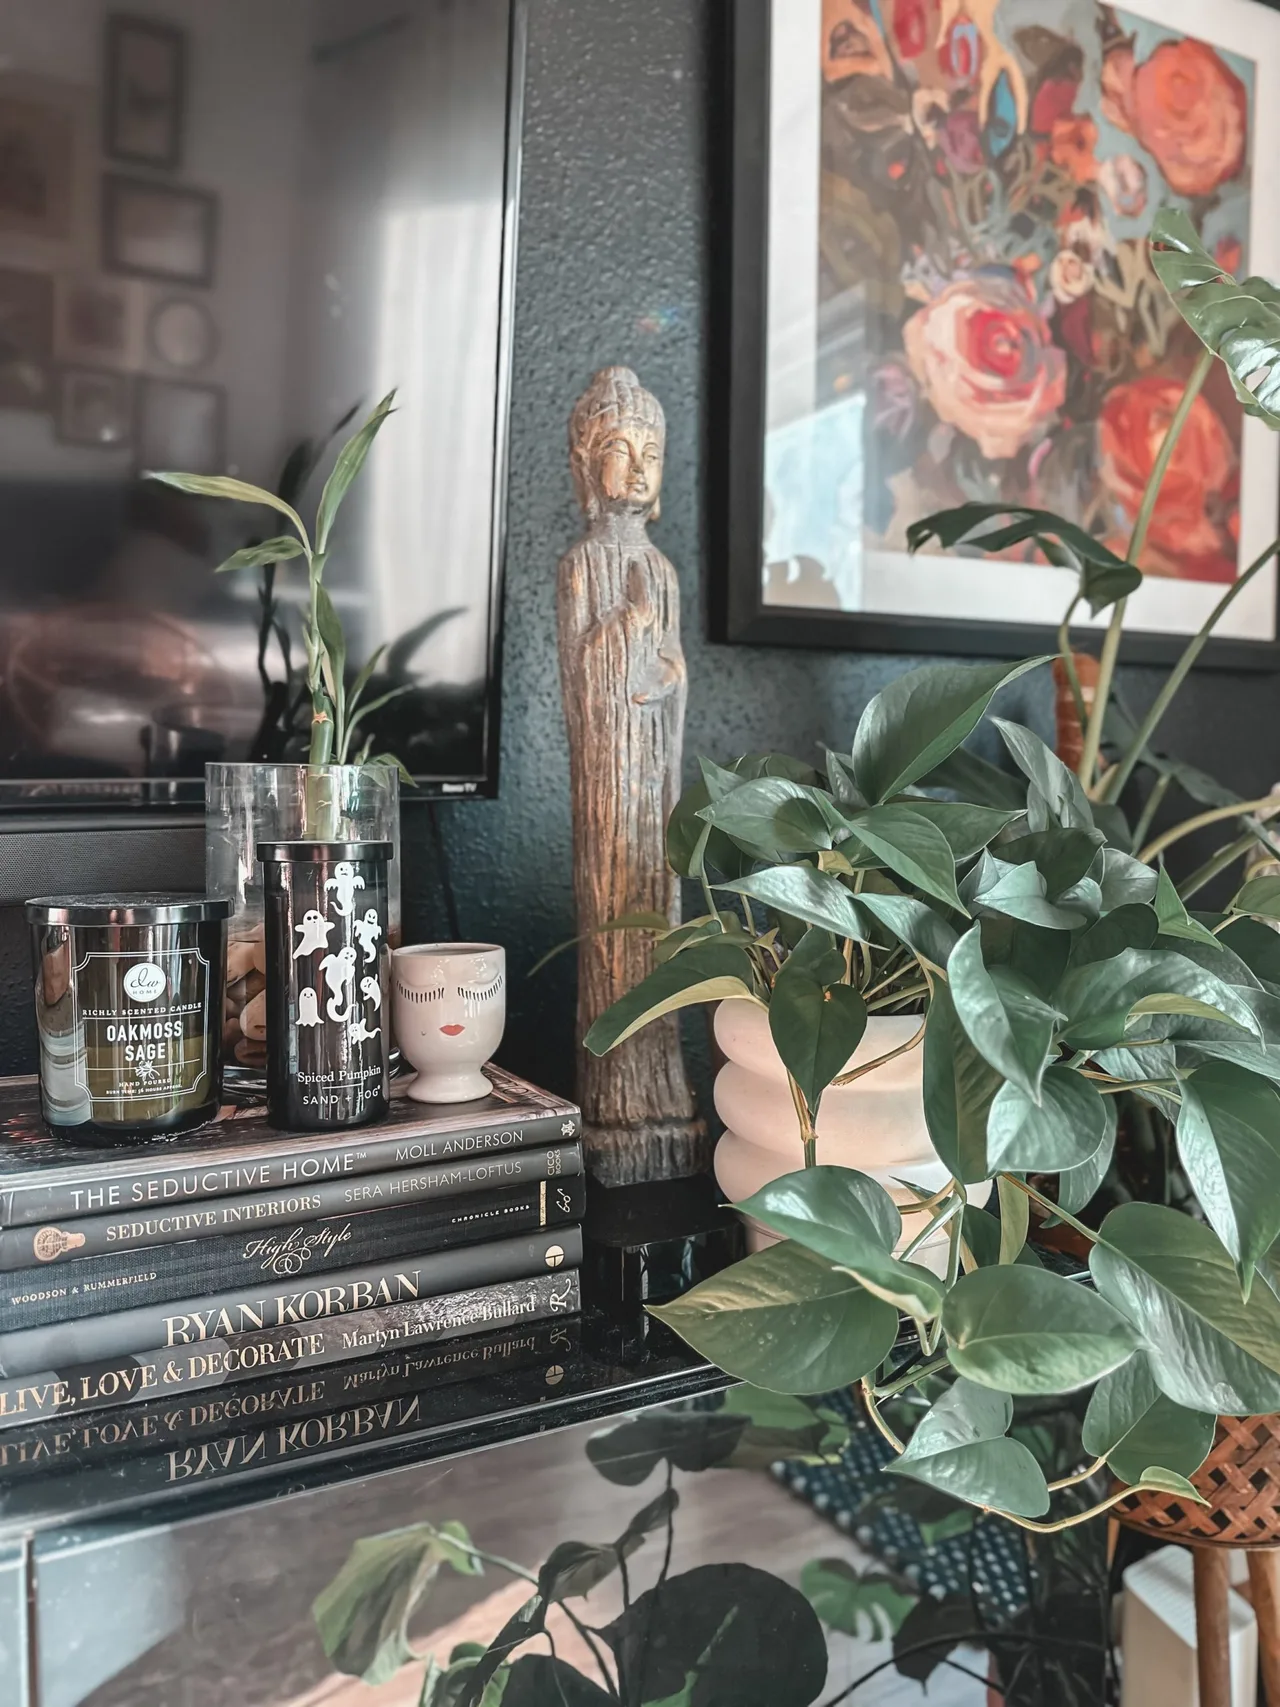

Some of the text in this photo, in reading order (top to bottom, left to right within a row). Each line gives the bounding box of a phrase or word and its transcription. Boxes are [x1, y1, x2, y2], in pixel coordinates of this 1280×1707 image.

[121, 1006, 167, 1016] SCENTED
[170, 1002, 202, 1012] CANDLE
[106, 1020, 182, 1042] OAKMOSS
[125, 1043, 166, 1062] SAGE
[143, 1078, 172, 1086] POURED
[297, 1065, 382, 1085] Spiced Pumpkin
[302, 1095, 339, 1105] SAND
[395, 1129, 524, 1162] MOLL ANDERSON
[546, 1150, 555, 1176] CICO
[70, 1185, 121, 1211] THE
[131, 1164, 271, 1203] SEDUCTIVE
[344, 1160, 523, 1203] SERA HERSHAM-LOFTUS
[106, 1194, 322, 1242] SEDUCTIVE INTERIORS
[451, 1204, 530, 1224] CHRONICLE BOOKS
[242, 1222, 352, 1270] High Style
[11, 1271, 157, 1306] WOODSON & RUMMERFIELD
[163, 1270, 422, 1350] RYAN KORBAN
[342, 1297, 536, 1350] Martyn Lawrence Bullard
[0, 1333, 325, 1417] LIVE, LOVE & DECORATE
